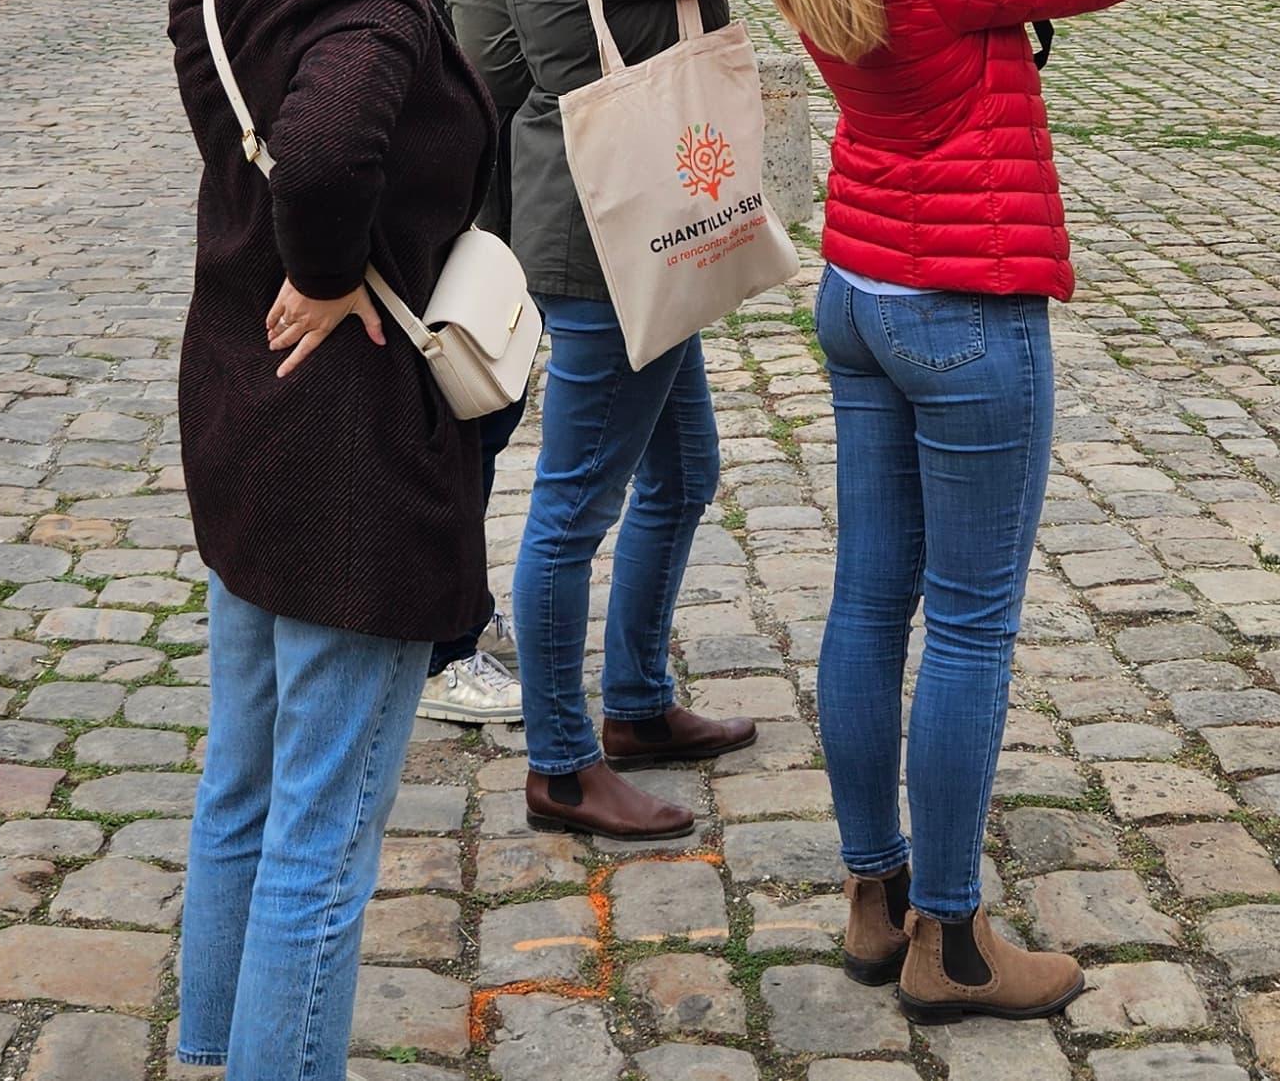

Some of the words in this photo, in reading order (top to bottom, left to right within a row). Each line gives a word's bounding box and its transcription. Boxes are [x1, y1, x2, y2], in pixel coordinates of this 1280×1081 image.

[650, 193, 763, 253] CHANTILLY-SEN
[667, 256, 678, 266] La
[680, 235, 729, 260] rencontre
[729, 227, 739, 239] de
[696, 258, 707, 268] et
[709, 251, 721, 264] de
